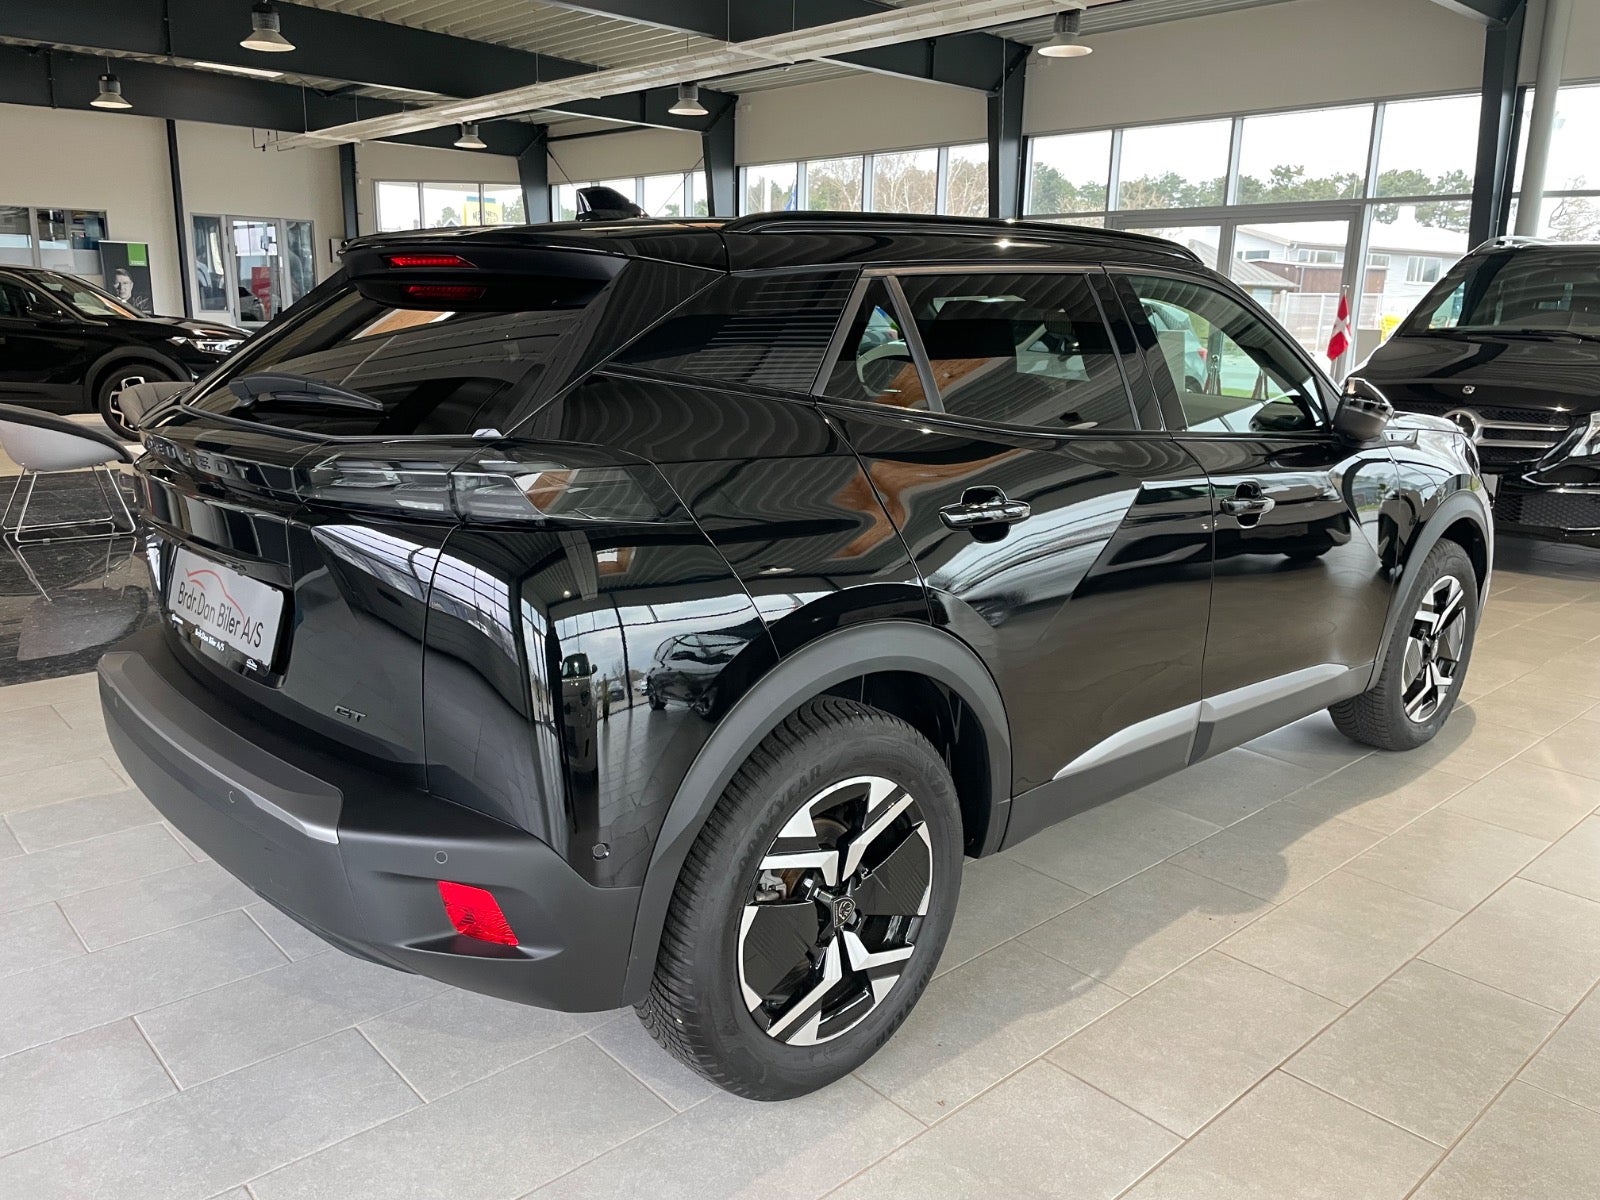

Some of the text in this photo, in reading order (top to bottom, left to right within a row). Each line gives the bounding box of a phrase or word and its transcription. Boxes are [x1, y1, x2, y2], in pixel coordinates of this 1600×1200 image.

[216, 602, 241, 636] Biler
[240, 615, 264, 648] A/S
[334, 705, 367, 721] GT
